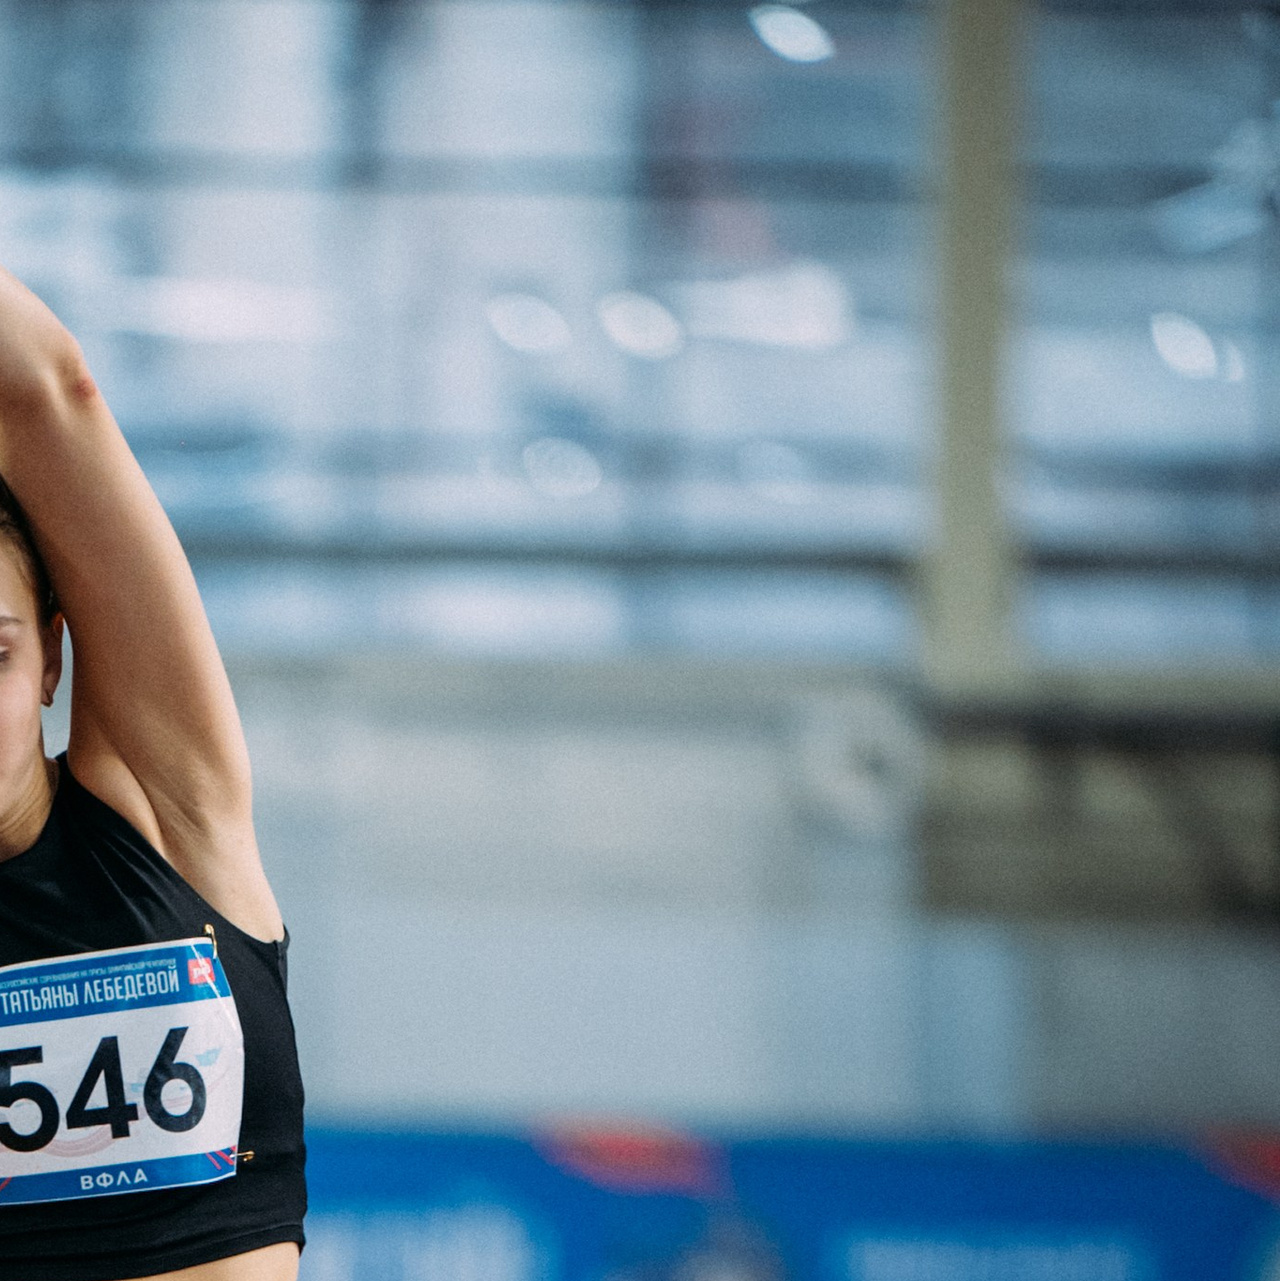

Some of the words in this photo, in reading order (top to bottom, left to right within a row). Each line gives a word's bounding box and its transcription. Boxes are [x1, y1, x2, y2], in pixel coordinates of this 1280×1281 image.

[0, 983, 80, 1015] ТАТЬЯНЫ
[84, 964, 180, 1002] ЛЕБЕДЕВОЙ
[80, 1168, 148, 1190] ВФЛА
